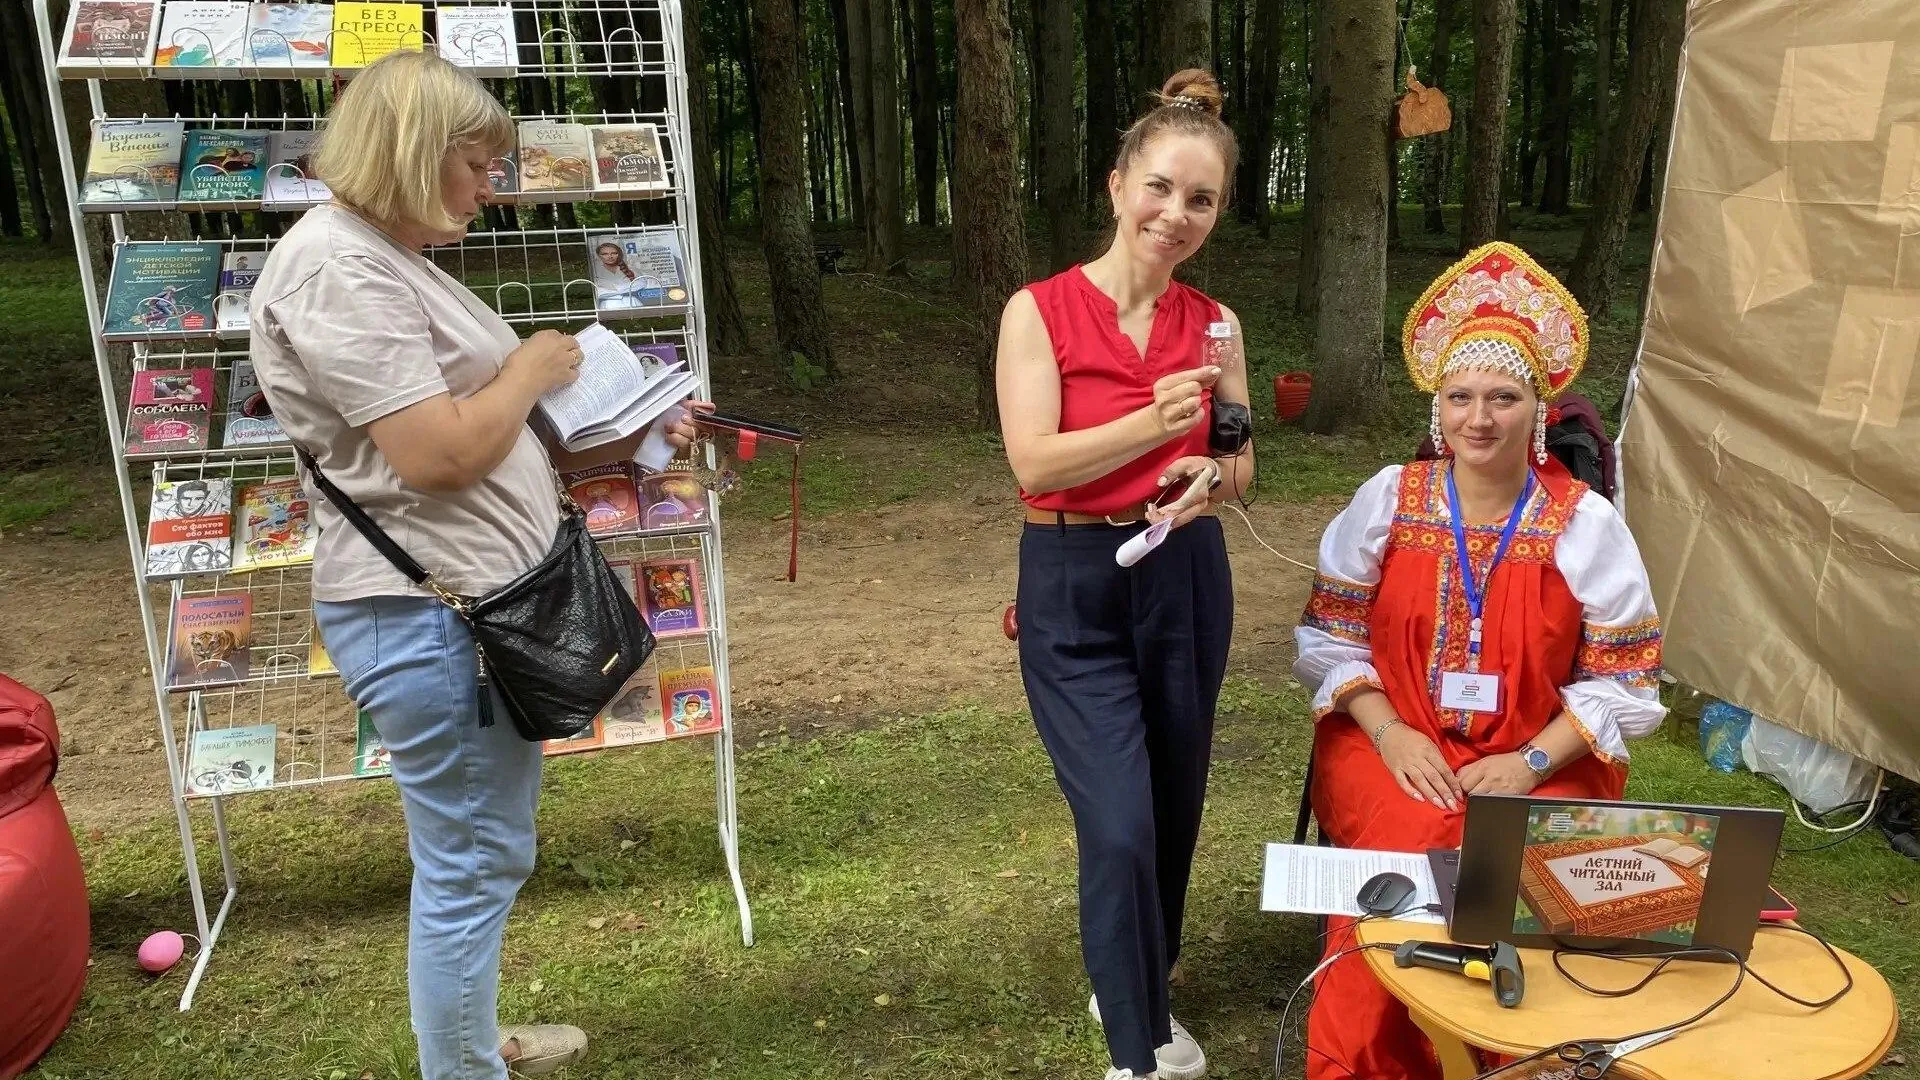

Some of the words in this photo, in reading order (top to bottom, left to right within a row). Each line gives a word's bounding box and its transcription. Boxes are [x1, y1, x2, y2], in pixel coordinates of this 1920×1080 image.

[361, 9, 397, 20] БЕЗ
[340, 22, 416, 33] СТРЕССА
[101, 131, 165, 144] Вкусная
[110, 142, 170, 154] Венеция
[625, 242, 638, 254] Я
[124, 256, 212, 264] ЭНЦИКЛОПЕДИЯ
[132, 268, 201, 276] МОТИВАЦИИ
[134, 403, 207, 415] СОБОЛЕВА
[171, 523, 188, 532] Сто
[189, 521, 224, 532] фактов
[181, 610, 245, 622] ПОЛОСАТЫЙ
[652, 608, 693, 619] СКАЗКИ
[182, 619, 241, 629] СЧАСТЛИВЧИК
[674, 673, 702, 681] ЕЛЕНА
[666, 678, 712, 690] ПРЕМУДРАЯ
[235, 737, 272, 748] ТИМОФЕЙ
[1585, 856, 1642, 870] ЛЕТНИЙ
[1569, 868, 1656, 882] ЧИТАЛЬНЫЙ
[1594, 880, 1623, 892] ЗАЛ
